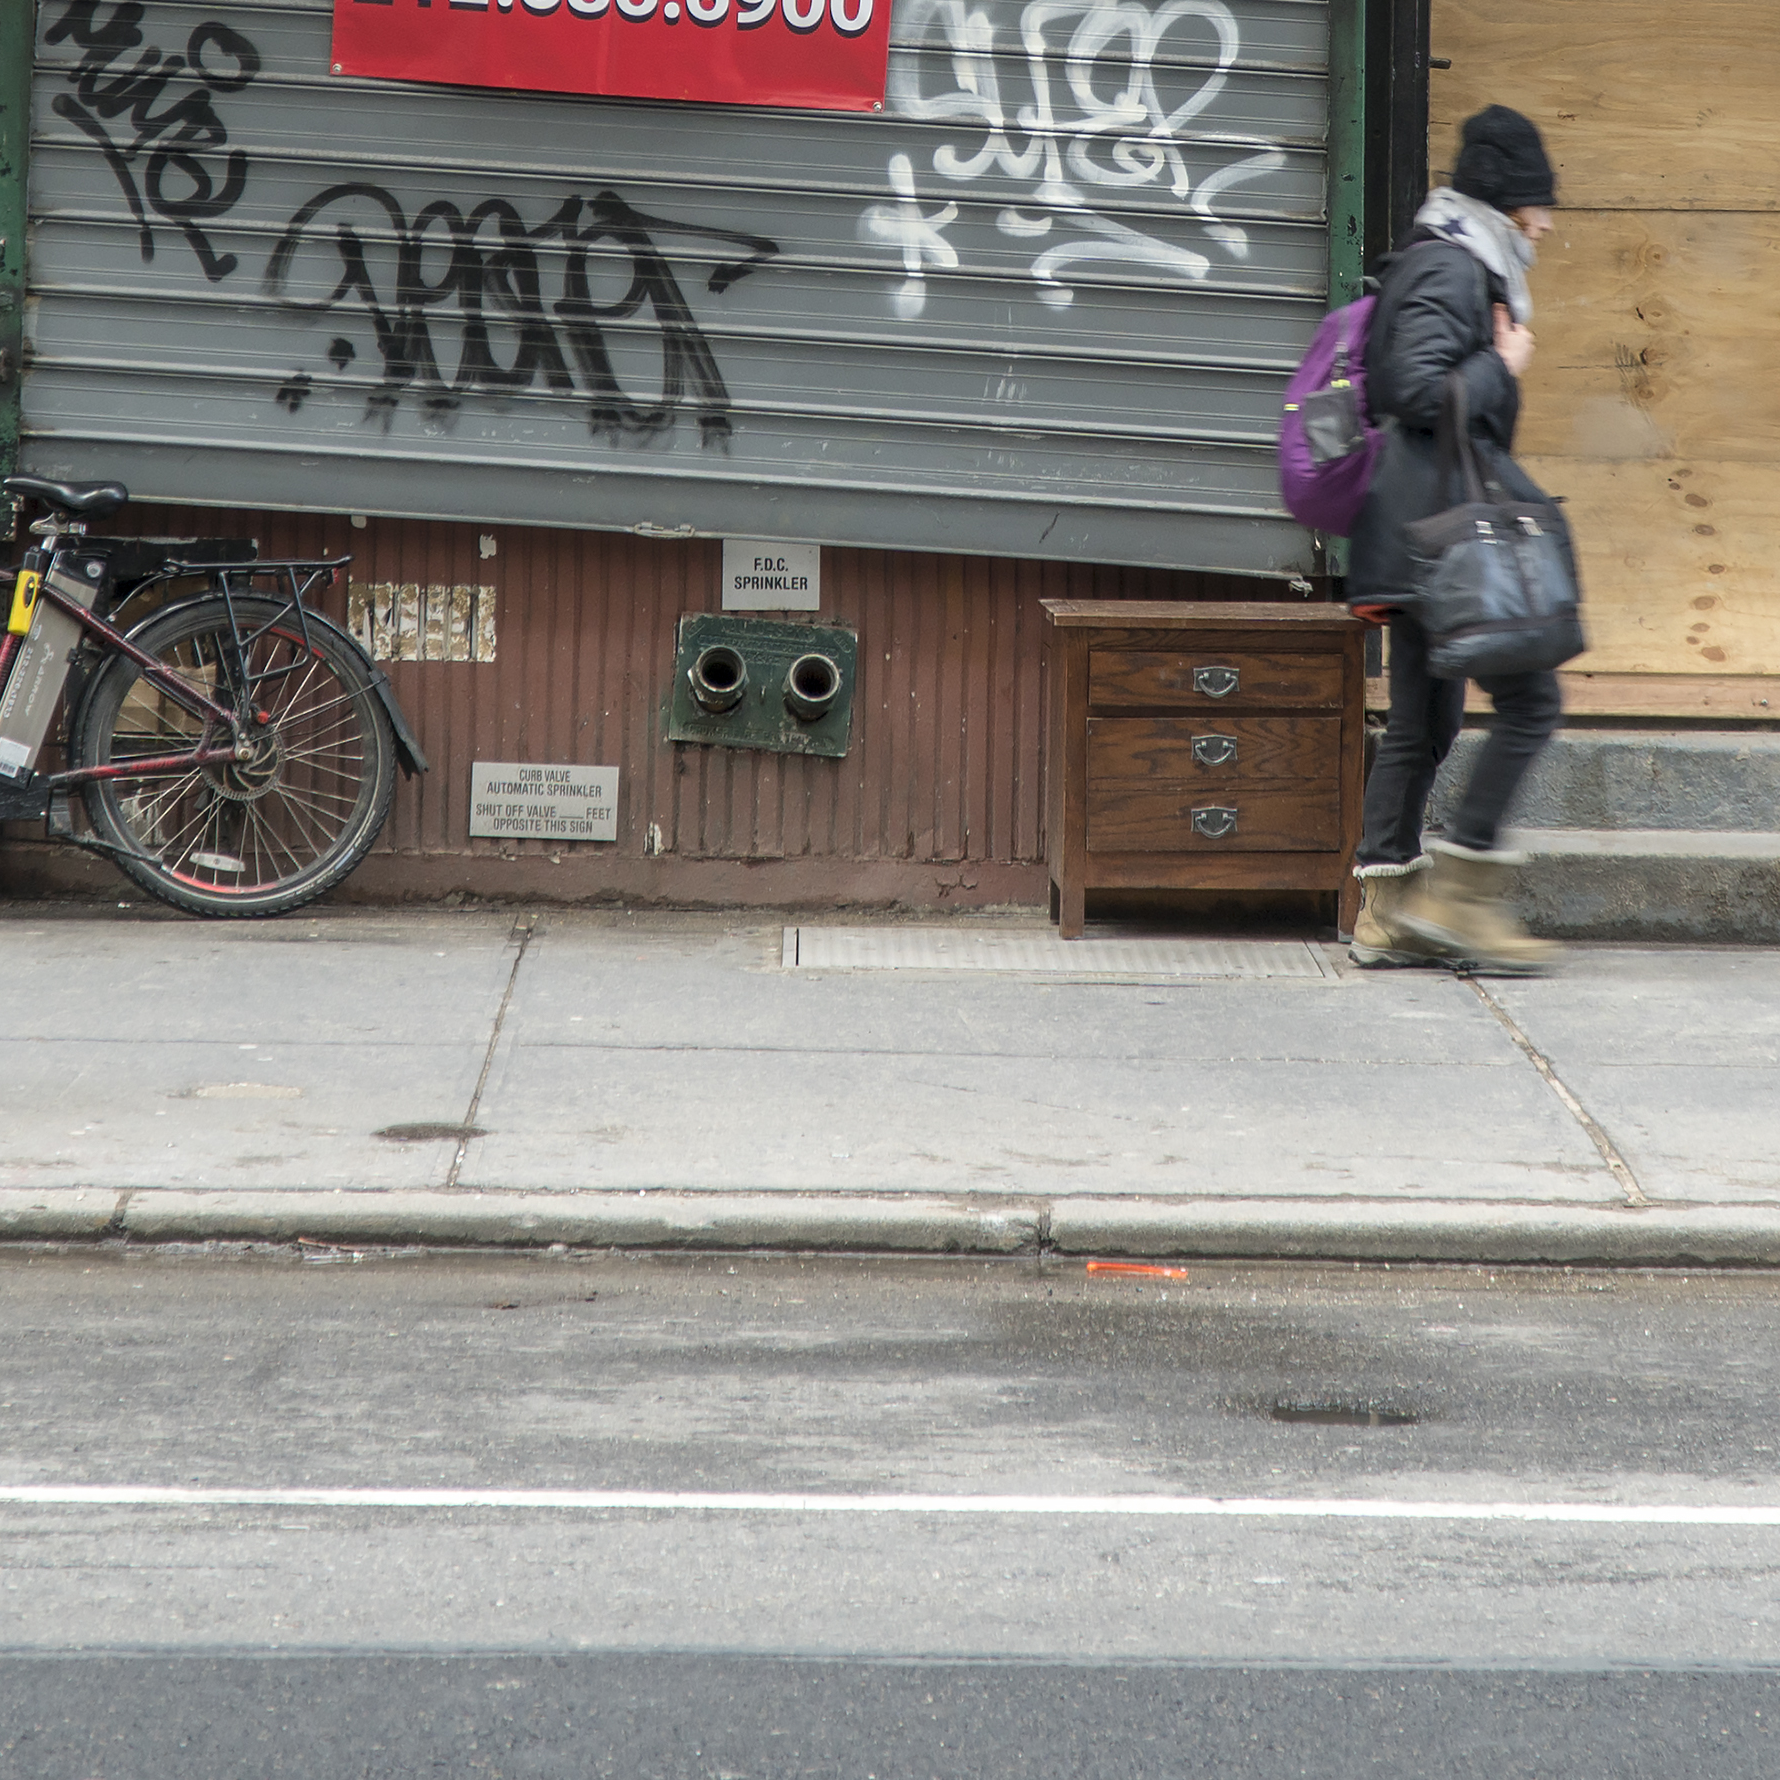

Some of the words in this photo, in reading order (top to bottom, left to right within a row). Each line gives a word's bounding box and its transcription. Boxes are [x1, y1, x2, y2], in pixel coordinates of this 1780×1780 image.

[753, 558, 789, 572] F.D.C.
[734, 576, 808, 591] SPRINKLER
[519, 769, 542, 782] CURB
[545, 770, 571, 783] VALVE
[486, 782, 544, 796] AUTOMATIC
[546, 784, 602, 797] SPRINKLER
[475, 804, 502, 817] SHUT
[505, 805, 524, 817] OFF
[526, 806, 556, 818] VALVE
[586, 807, 611, 820] FEET
[493, 818, 541, 832] OPPOSITE
[544, 820, 566, 833] THIS
[569, 821, 592, 833] SIGN
